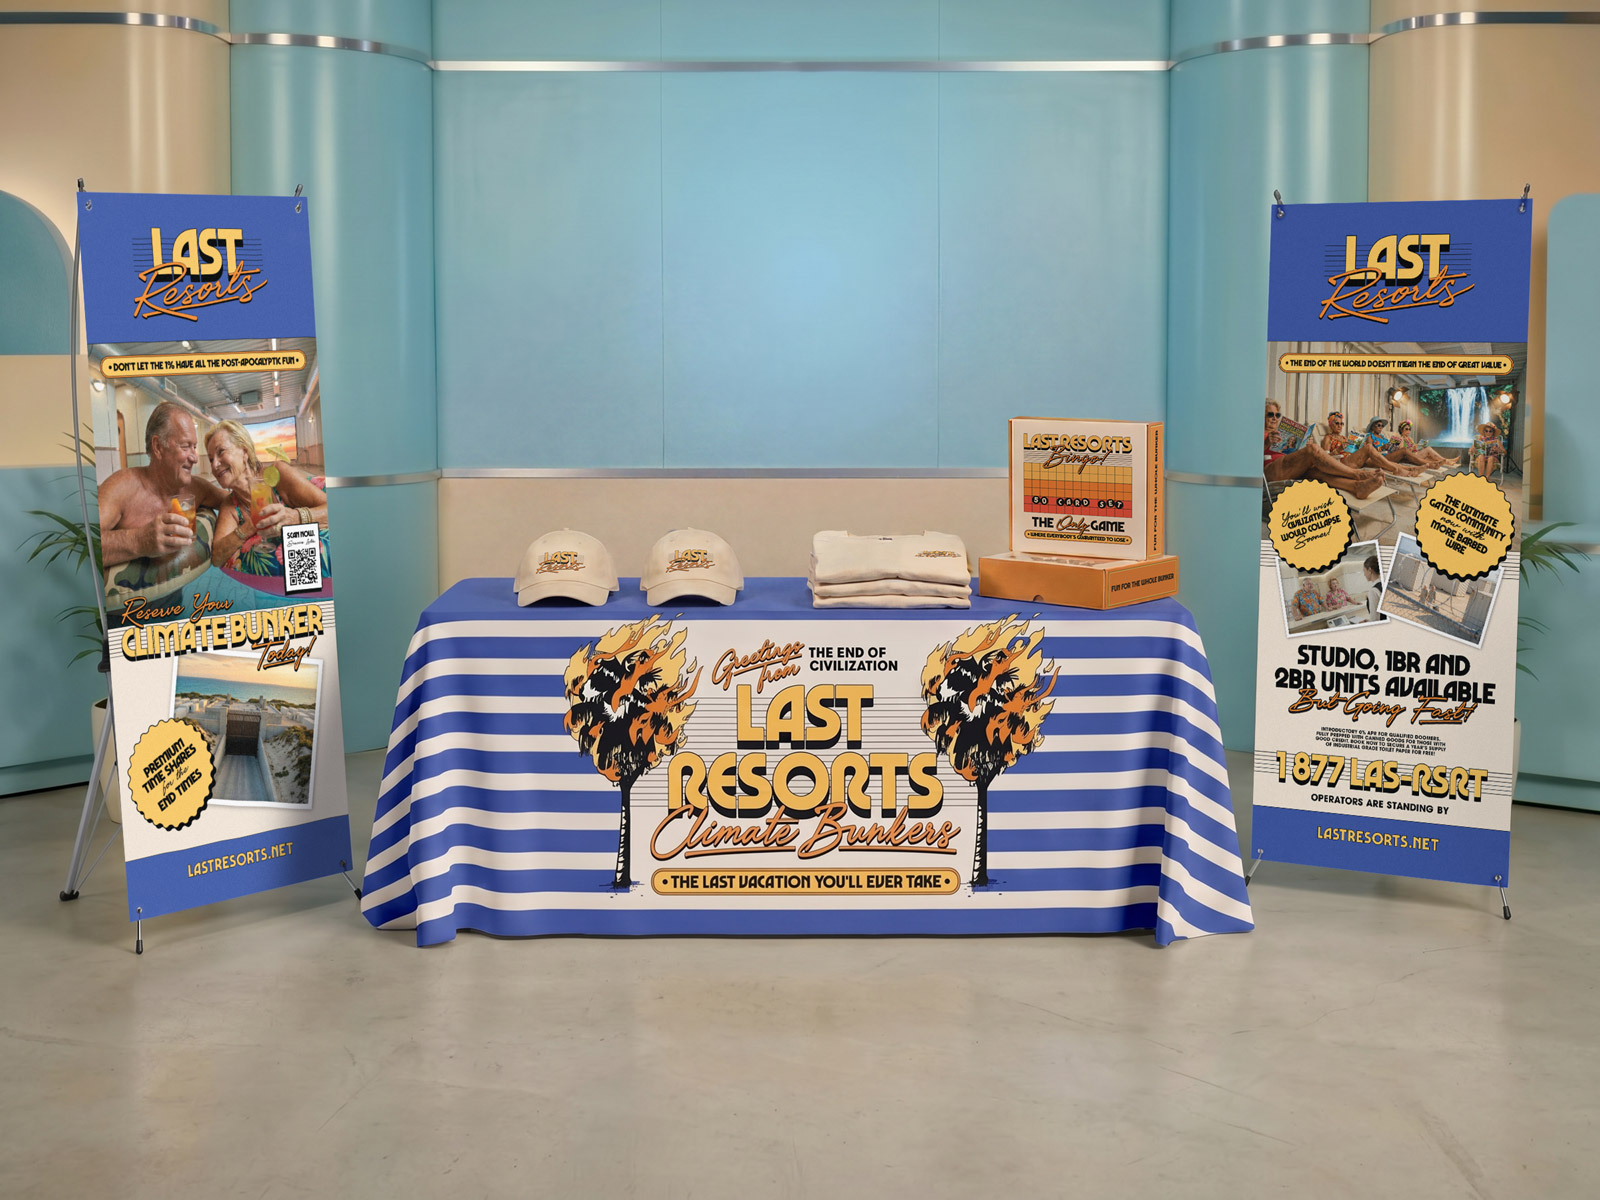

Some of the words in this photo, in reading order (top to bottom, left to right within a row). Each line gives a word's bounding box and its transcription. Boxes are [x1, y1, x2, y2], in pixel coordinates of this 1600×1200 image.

[151, 228, 243, 282] LAST
[1345, 234, 1450, 286] LAST
[134, 261, 268, 321] Resorts
[1319, 265, 1475, 323] Resorts
[114, 362, 135, 371] DON'T
[137, 362, 148, 370] LET
[150, 361, 164, 370] THE
[165, 361, 174, 369] 1%
[176, 360, 193, 368] HAVE
[195, 360, 206, 368] ALL
[221, 357, 281, 367] POST-APOCALYPTIC
[282, 356, 295, 364] FUN
[1023, 433, 1059, 450] LAST
[1060, 435, 1132, 453] RESORTS
[1042, 444, 1111, 475] Bingo!
[1033, 496, 1048, 505] 50
[1057, 498, 1089, 507] CARD
[1099, 499, 1122, 509] SET
[1281, 505, 1311, 527] You'll
[1313, 497, 1334, 511] wish
[1445, 494, 1461, 508] THE
[1461, 502, 1499, 528] ULTIMATE
[1032, 517, 1054, 528] THE
[1056, 515, 1090, 536] Only
[1091, 520, 1125, 532] GAME
[1281, 526, 1307, 541] WOULD
[1308, 515, 1341, 532] COLLAPSE
[1288, 509, 1331, 529] CIVILIZATION
[1430, 498, 1455, 516] GATED
[1456, 512, 1506, 541] COMMUNITY
[1440, 517, 1461, 528] now
[1462, 527, 1485, 540] with
[1294, 526, 1332, 550] Sooner!
[1430, 520, 1457, 539] MORE
[1457, 533, 1488, 554] BARBED
[1445, 538, 1467, 555] WIRE
[544, 551, 578, 565] LAST
[674, 549, 707, 563] LAST
[1141, 576, 1157, 585] WHOLE
[121, 596, 185, 628] Reserve
[190, 592, 234, 623] Your
[122, 616, 228, 661] CLIMATE
[230, 604, 324, 648] BUNKER
[251, 635, 317, 672] Today!
[712, 639, 805, 690] Greetings
[809, 647, 833, 658] THE
[837, 647, 864, 658] END
[868, 647, 886, 658] OF
[809, 660, 898, 671] CIVILIZATION
[1297, 644, 1379, 672] STUDIO,
[1385, 650, 1421, 673] 1BR
[1426, 654, 1470, 676] AND
[757, 664, 800, 694] from
[1275, 667, 1316, 690] 2BR
[1321, 670, 1380, 695] UNITS
[1385, 676, 1496, 704] AVAILABLE
[736, 684, 874, 749] LAST
[1288, 688, 1348, 714] But
[1343, 691, 1406, 728] Going
[1411, 695, 1479, 726] Fast!
[142, 770, 166, 794] TIME
[164, 744, 196, 776] SHARES
[143, 738, 185, 778] PREMIUM
[158, 792, 176, 812] END
[175, 768, 202, 796] TIMES
[162, 779, 174, 796] for
[176, 766, 189, 780] the
[667, 752, 943, 820] RESORTS
[1350, 758, 1488, 802] LAS-RSRT
[1311, 794, 1363, 807] OPERATORS
[1366, 798, 1384, 809] ARE
[1387, 800, 1434, 813] STANDING
[1437, 806, 1449, 815] BY
[650, 804, 801, 861] Climate
[797, 802, 962, 860] Bunkers
[1317, 826, 1439, 851] LASTRESORTS.NET
[188, 842, 294, 878] LASTRESORTS.NET
[671, 875, 699, 889] THE
[703, 875, 734, 889] LAST
[739, 875, 810, 889] VACATION
[814, 875, 862, 889] YOU'LL
[867, 875, 902, 889] EVER
[906, 875, 941, 889] TAKE
